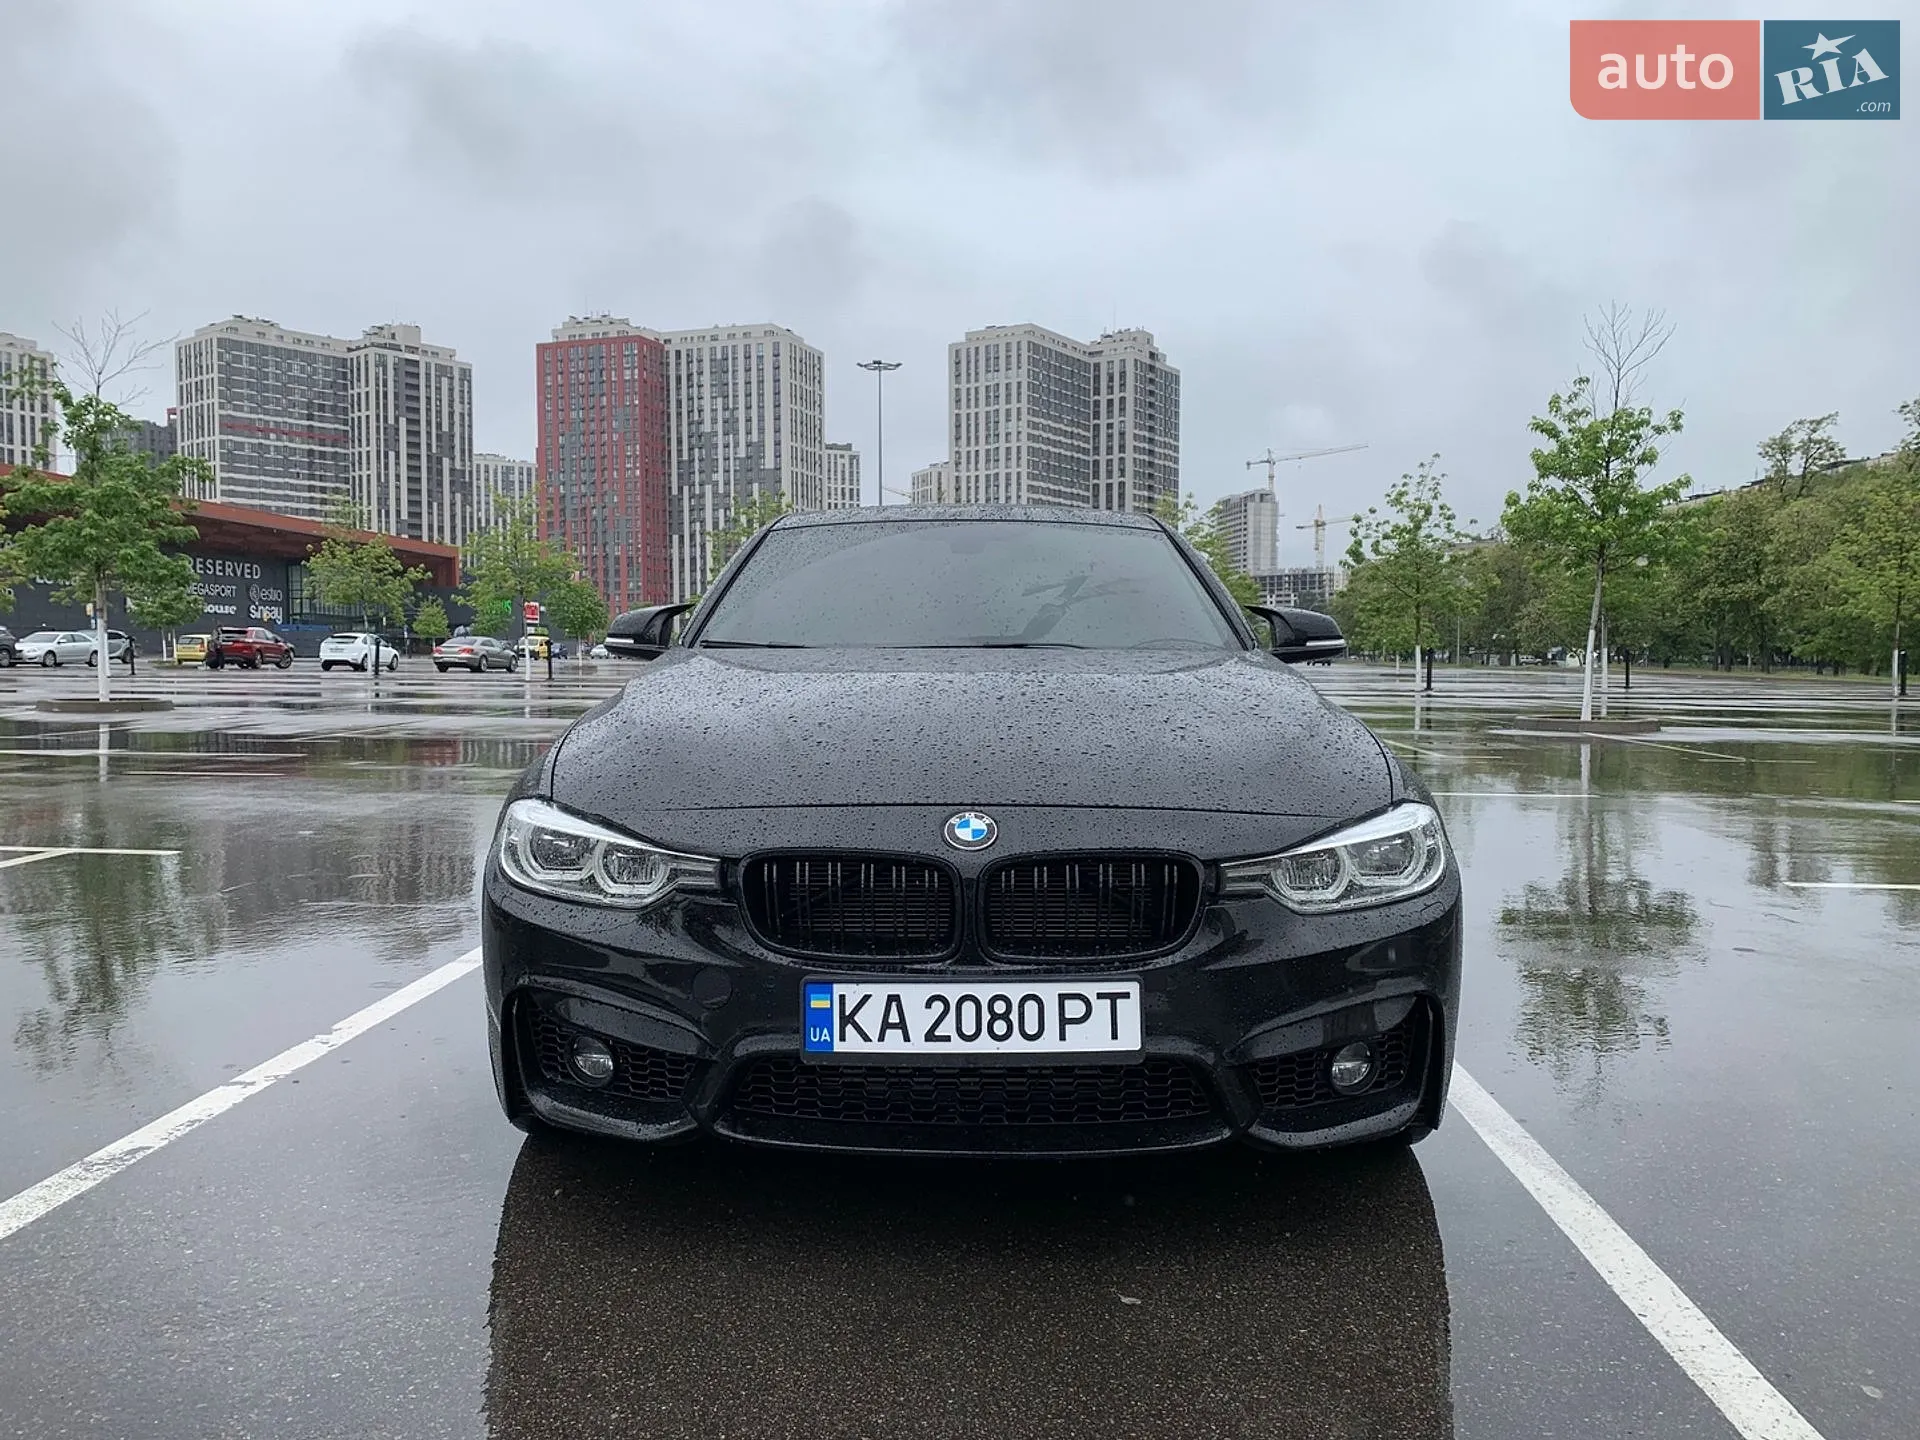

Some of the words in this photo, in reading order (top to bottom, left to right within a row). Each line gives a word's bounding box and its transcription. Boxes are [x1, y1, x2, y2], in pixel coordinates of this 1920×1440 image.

[810, 1026, 831, 1042] UA
[838, 993, 912, 1043] KA
[923, 992, 1046, 1043] 2080
[1057, 991, 1131, 1042] PT
